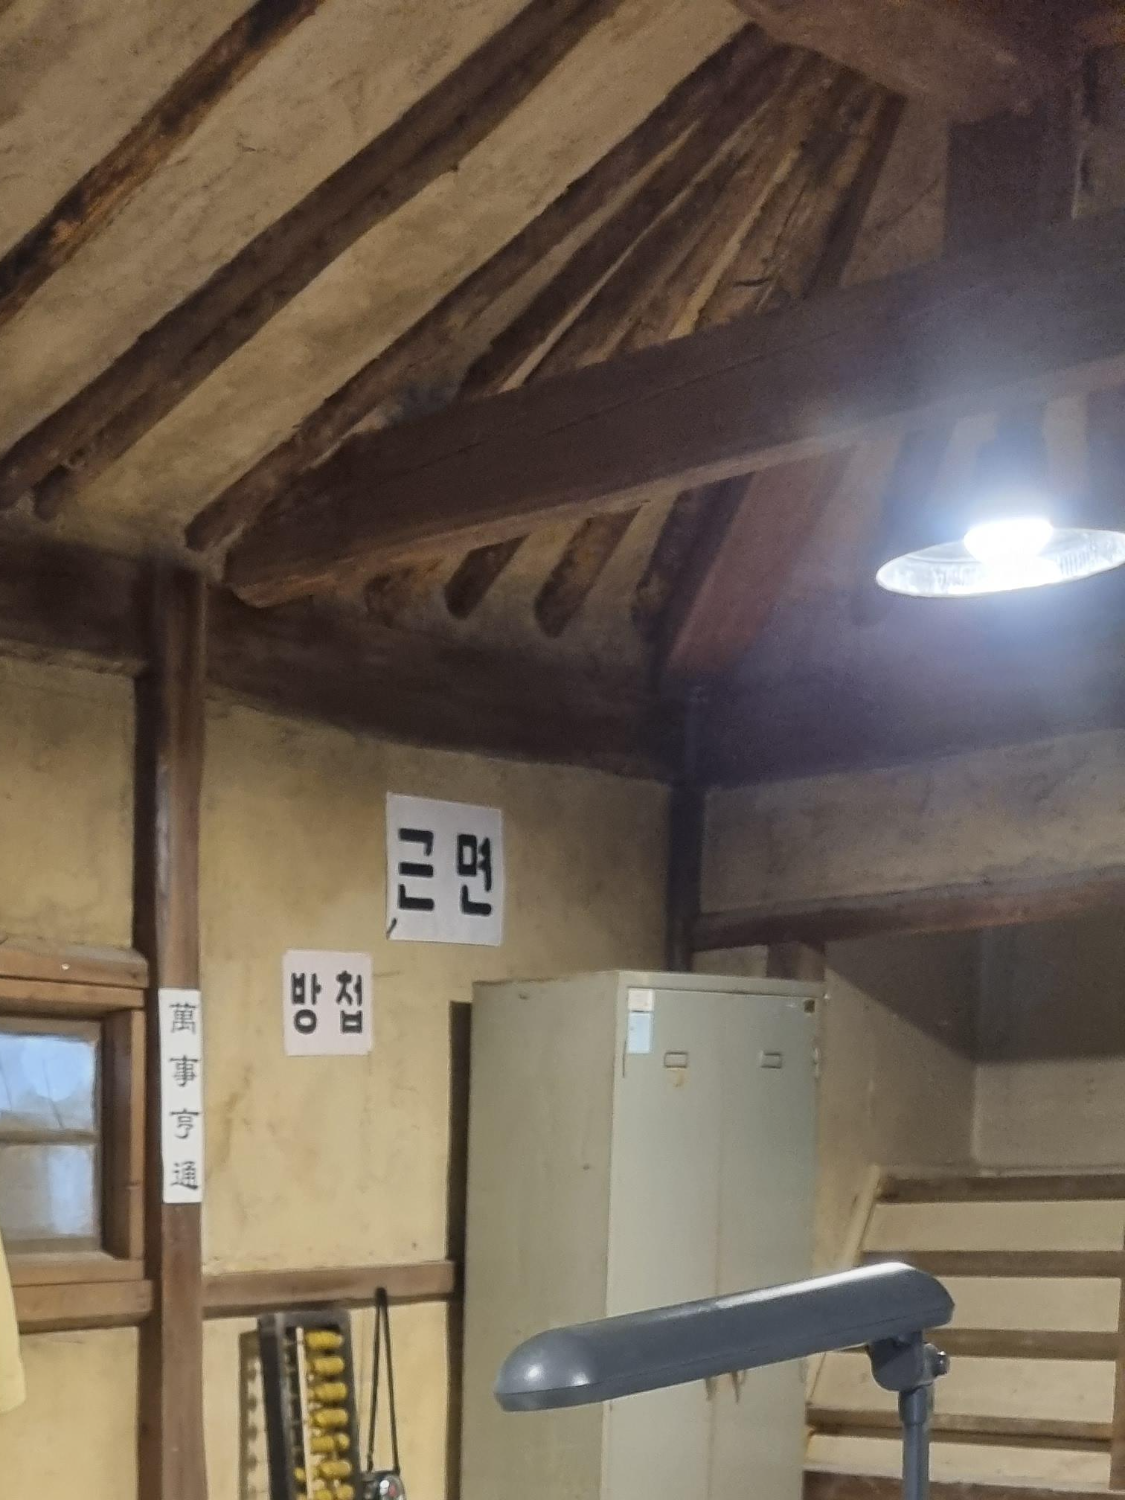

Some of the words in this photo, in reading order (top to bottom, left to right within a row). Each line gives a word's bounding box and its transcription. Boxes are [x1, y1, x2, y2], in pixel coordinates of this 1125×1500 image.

[397, 827, 493, 917] 근면
[291, 971, 363, 1034] 방첩
[169, 1002, 199, 1191] 萬事亨通
